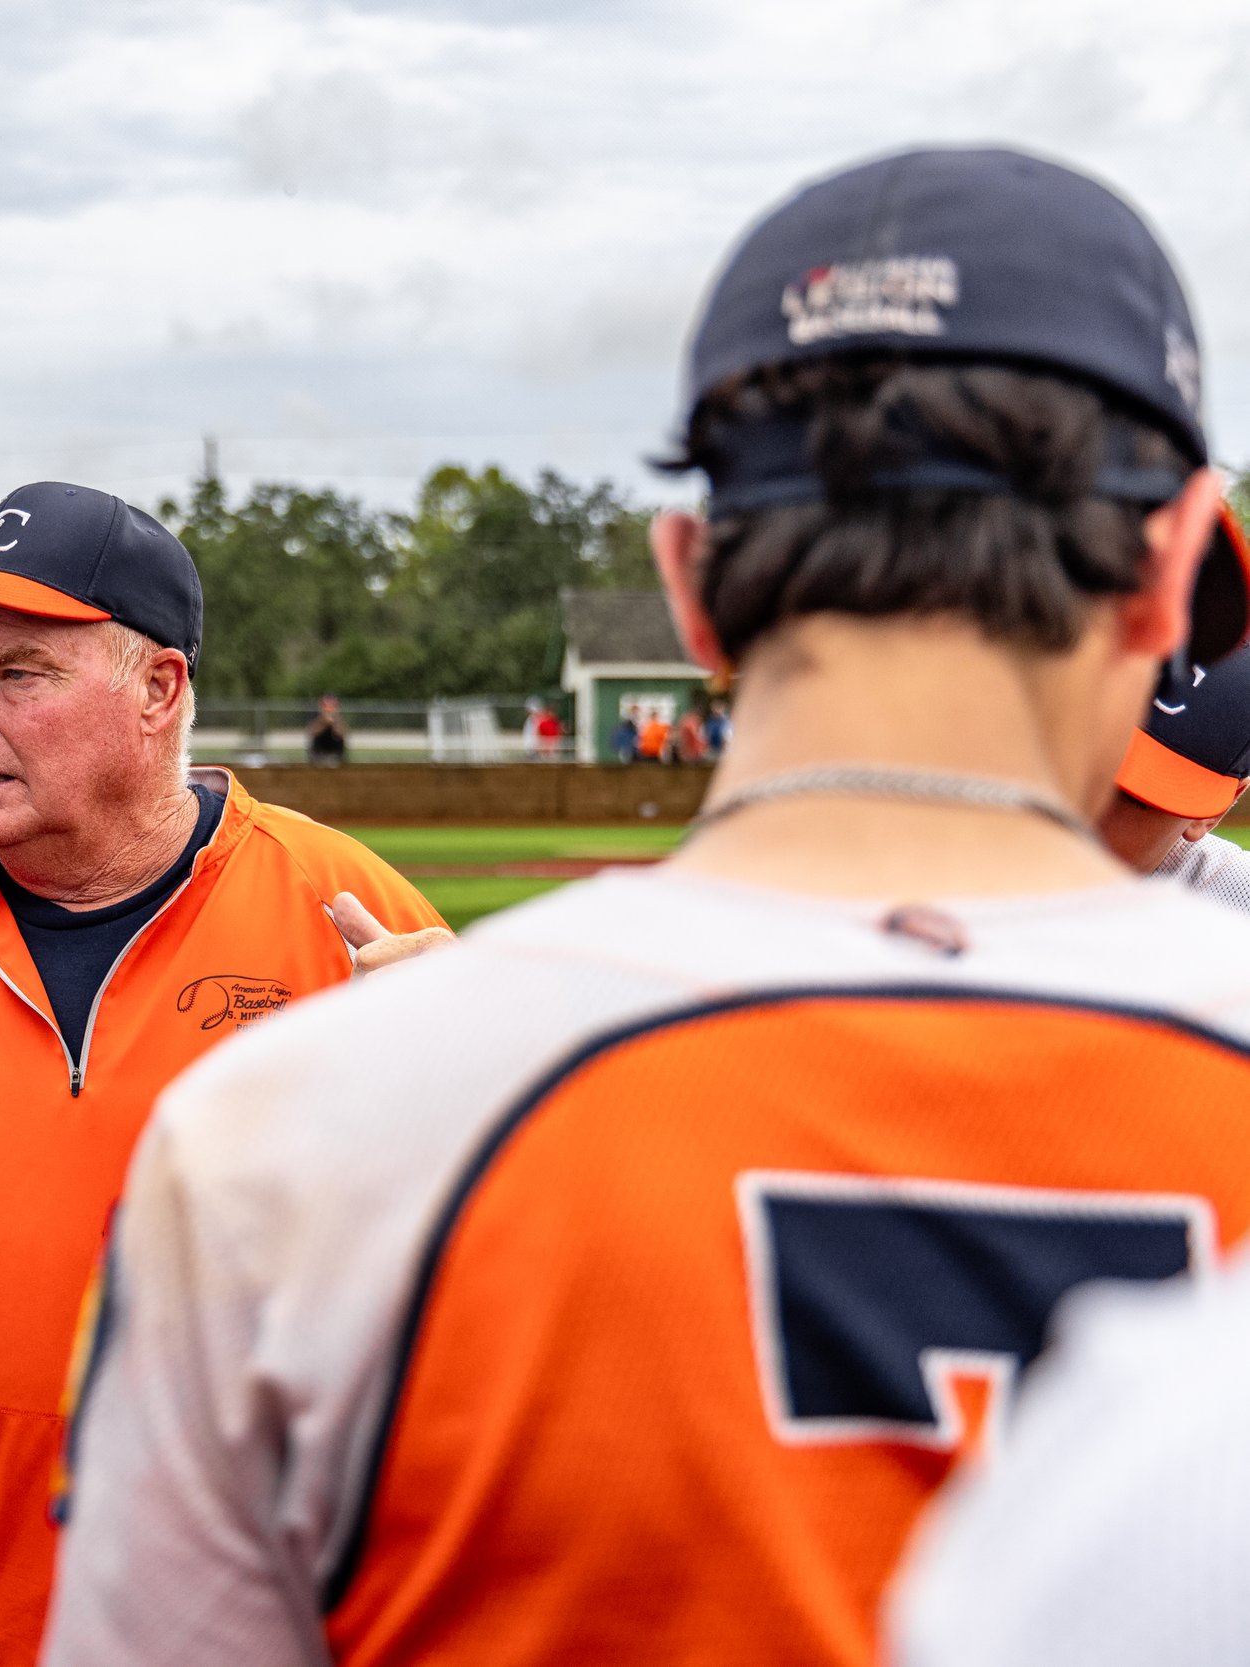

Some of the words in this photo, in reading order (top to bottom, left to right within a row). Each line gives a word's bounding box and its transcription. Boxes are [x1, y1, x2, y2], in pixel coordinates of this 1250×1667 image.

[231, 983, 266, 994] American
[268, 984, 292, 998] Legion
[233, 994, 288, 1011] Baseball
[240, 1011, 264, 1020] MIKE
